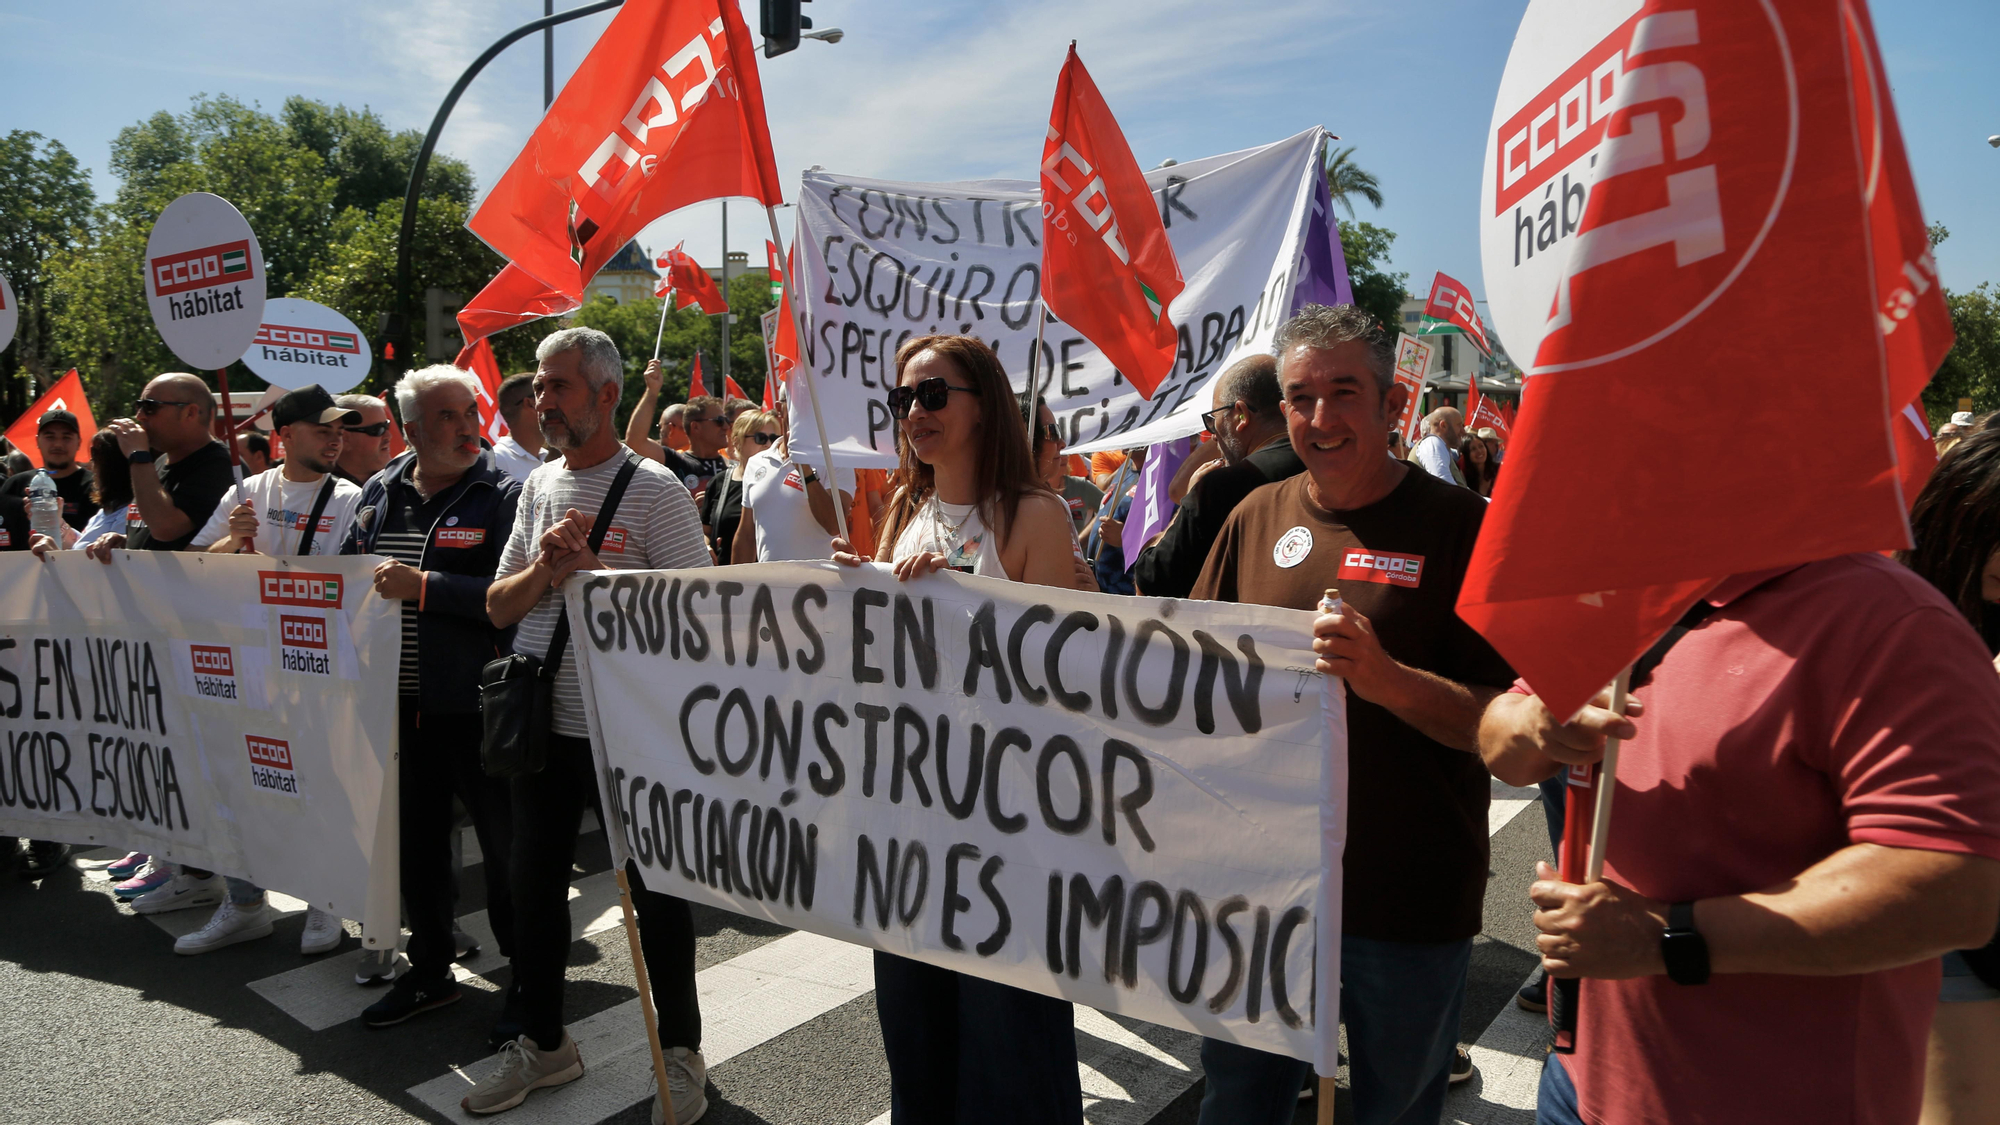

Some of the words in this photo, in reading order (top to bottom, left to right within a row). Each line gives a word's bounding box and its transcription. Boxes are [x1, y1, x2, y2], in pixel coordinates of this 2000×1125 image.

[1503, 48, 1624, 192] CCOO
[157, 254, 220, 287] CCOO
[169, 284, 244, 321] hábitat
[262, 345, 349, 368] hábitat
[1018, 336, 1090, 399] DE
[438, 531, 475, 541] CCOO
[1344, 553, 1405, 571] CCOO
[264, 577, 324, 601] CCOO
[1385, 571, 1417, 582] Córdoba
[283, 621, 324, 643] CCOO
[192, 650, 231, 671] CCOO
[282, 648, 330, 675] hábitat
[582, 574, 829, 675] GRUISTAS
[851, 586, 942, 691] EN
[962, 598, 1266, 735] ACCIÓN
[34, 638, 82, 720] EN
[85, 636, 167, 736] LUCHA
[194, 676, 237, 700] hábitat
[250, 741, 289, 764] CCOO
[251, 766, 297, 794] hábitat
[678, 681, 1156, 853] CONSTRUCOR
[87, 731, 190, 831] ESCUCHA
[852, 833, 930, 931] NO
[940, 841, 1012, 958] ES
